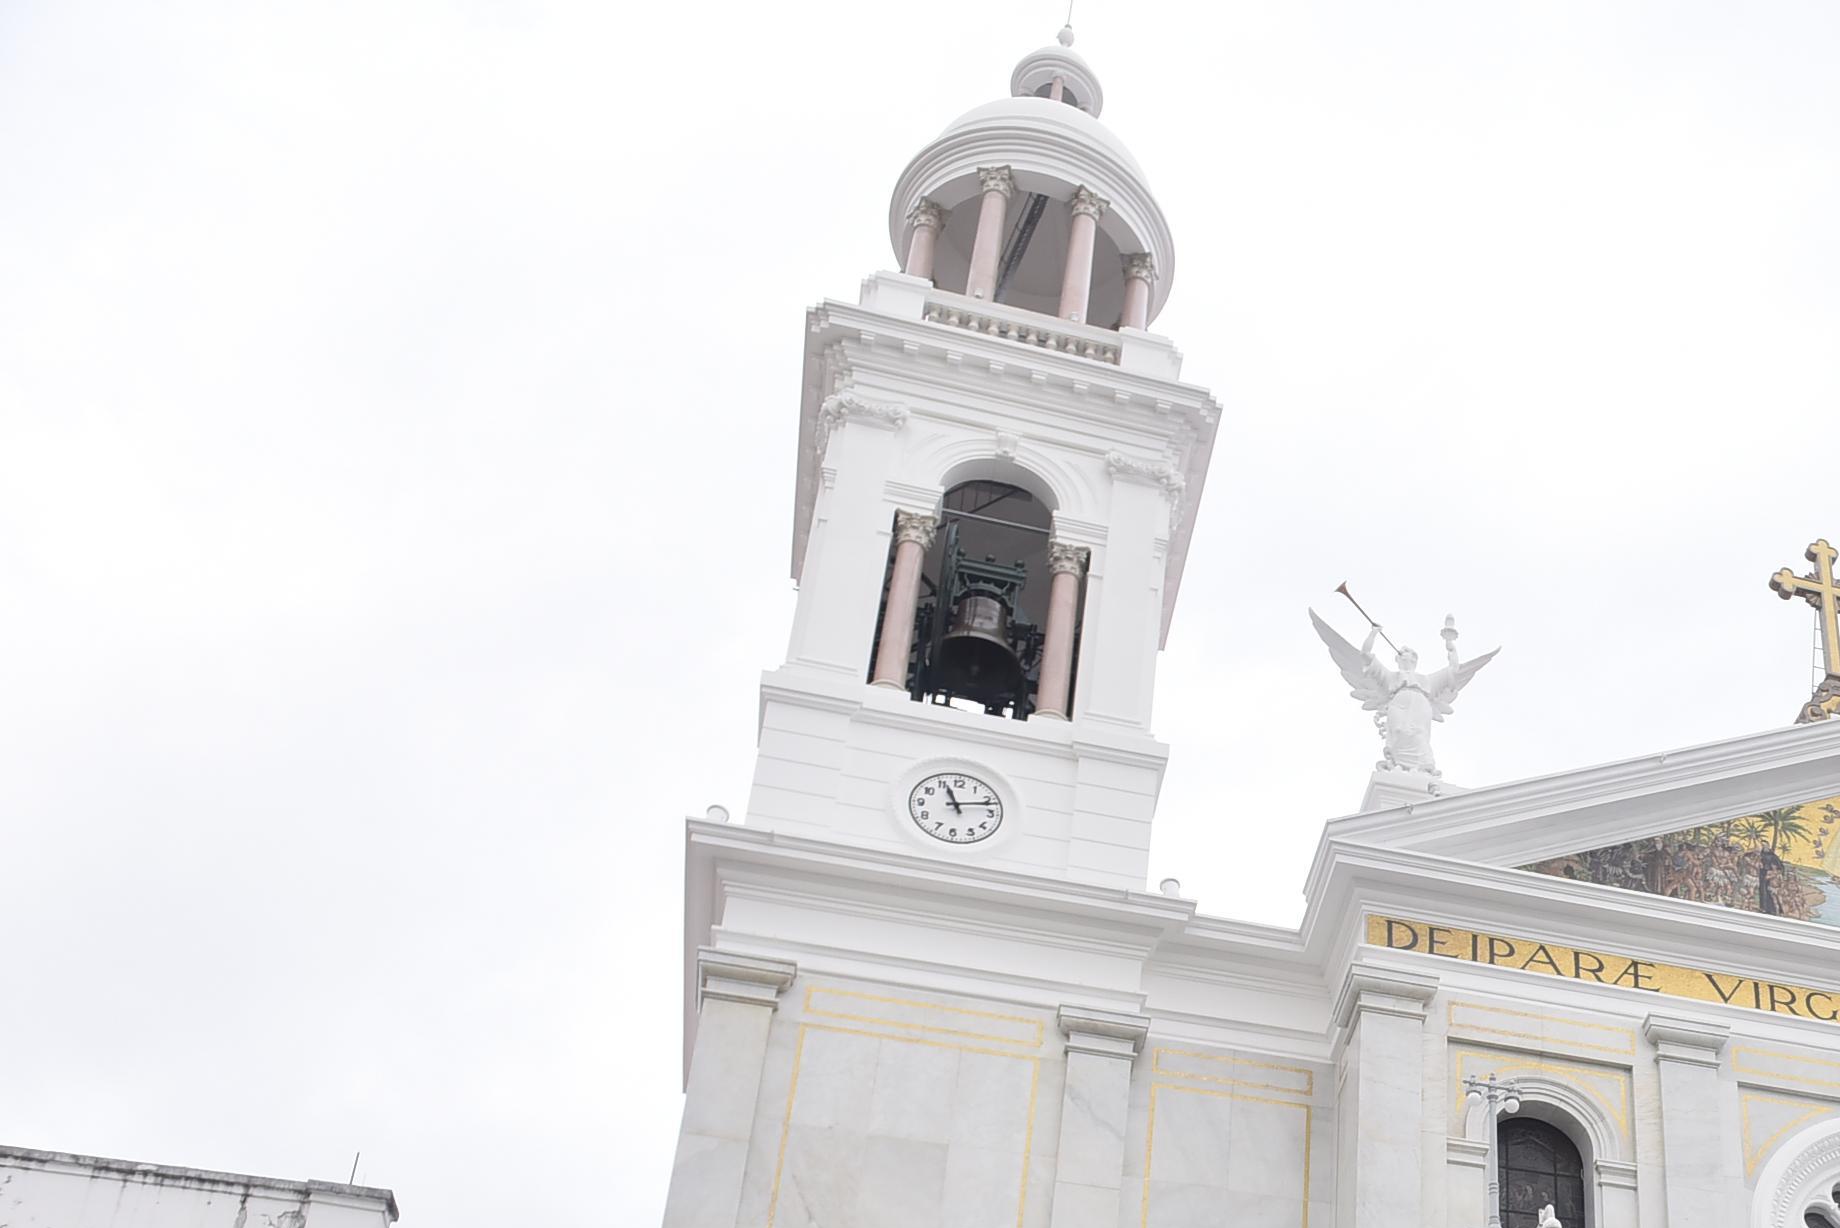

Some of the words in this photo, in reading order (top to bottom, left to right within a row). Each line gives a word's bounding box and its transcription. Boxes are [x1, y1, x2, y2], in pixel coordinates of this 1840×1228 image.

[954, 780, 966, 789] 12
[924, 787, 935, 796] 10
[917, 798, 925, 806] 9
[921, 811, 929, 820] 8
[986, 809, 994, 818] 3
[935, 822, 944, 831] 7
[949, 828, 957, 837] 6
[1386, 919, 1661, 992] DEIPARÆ
